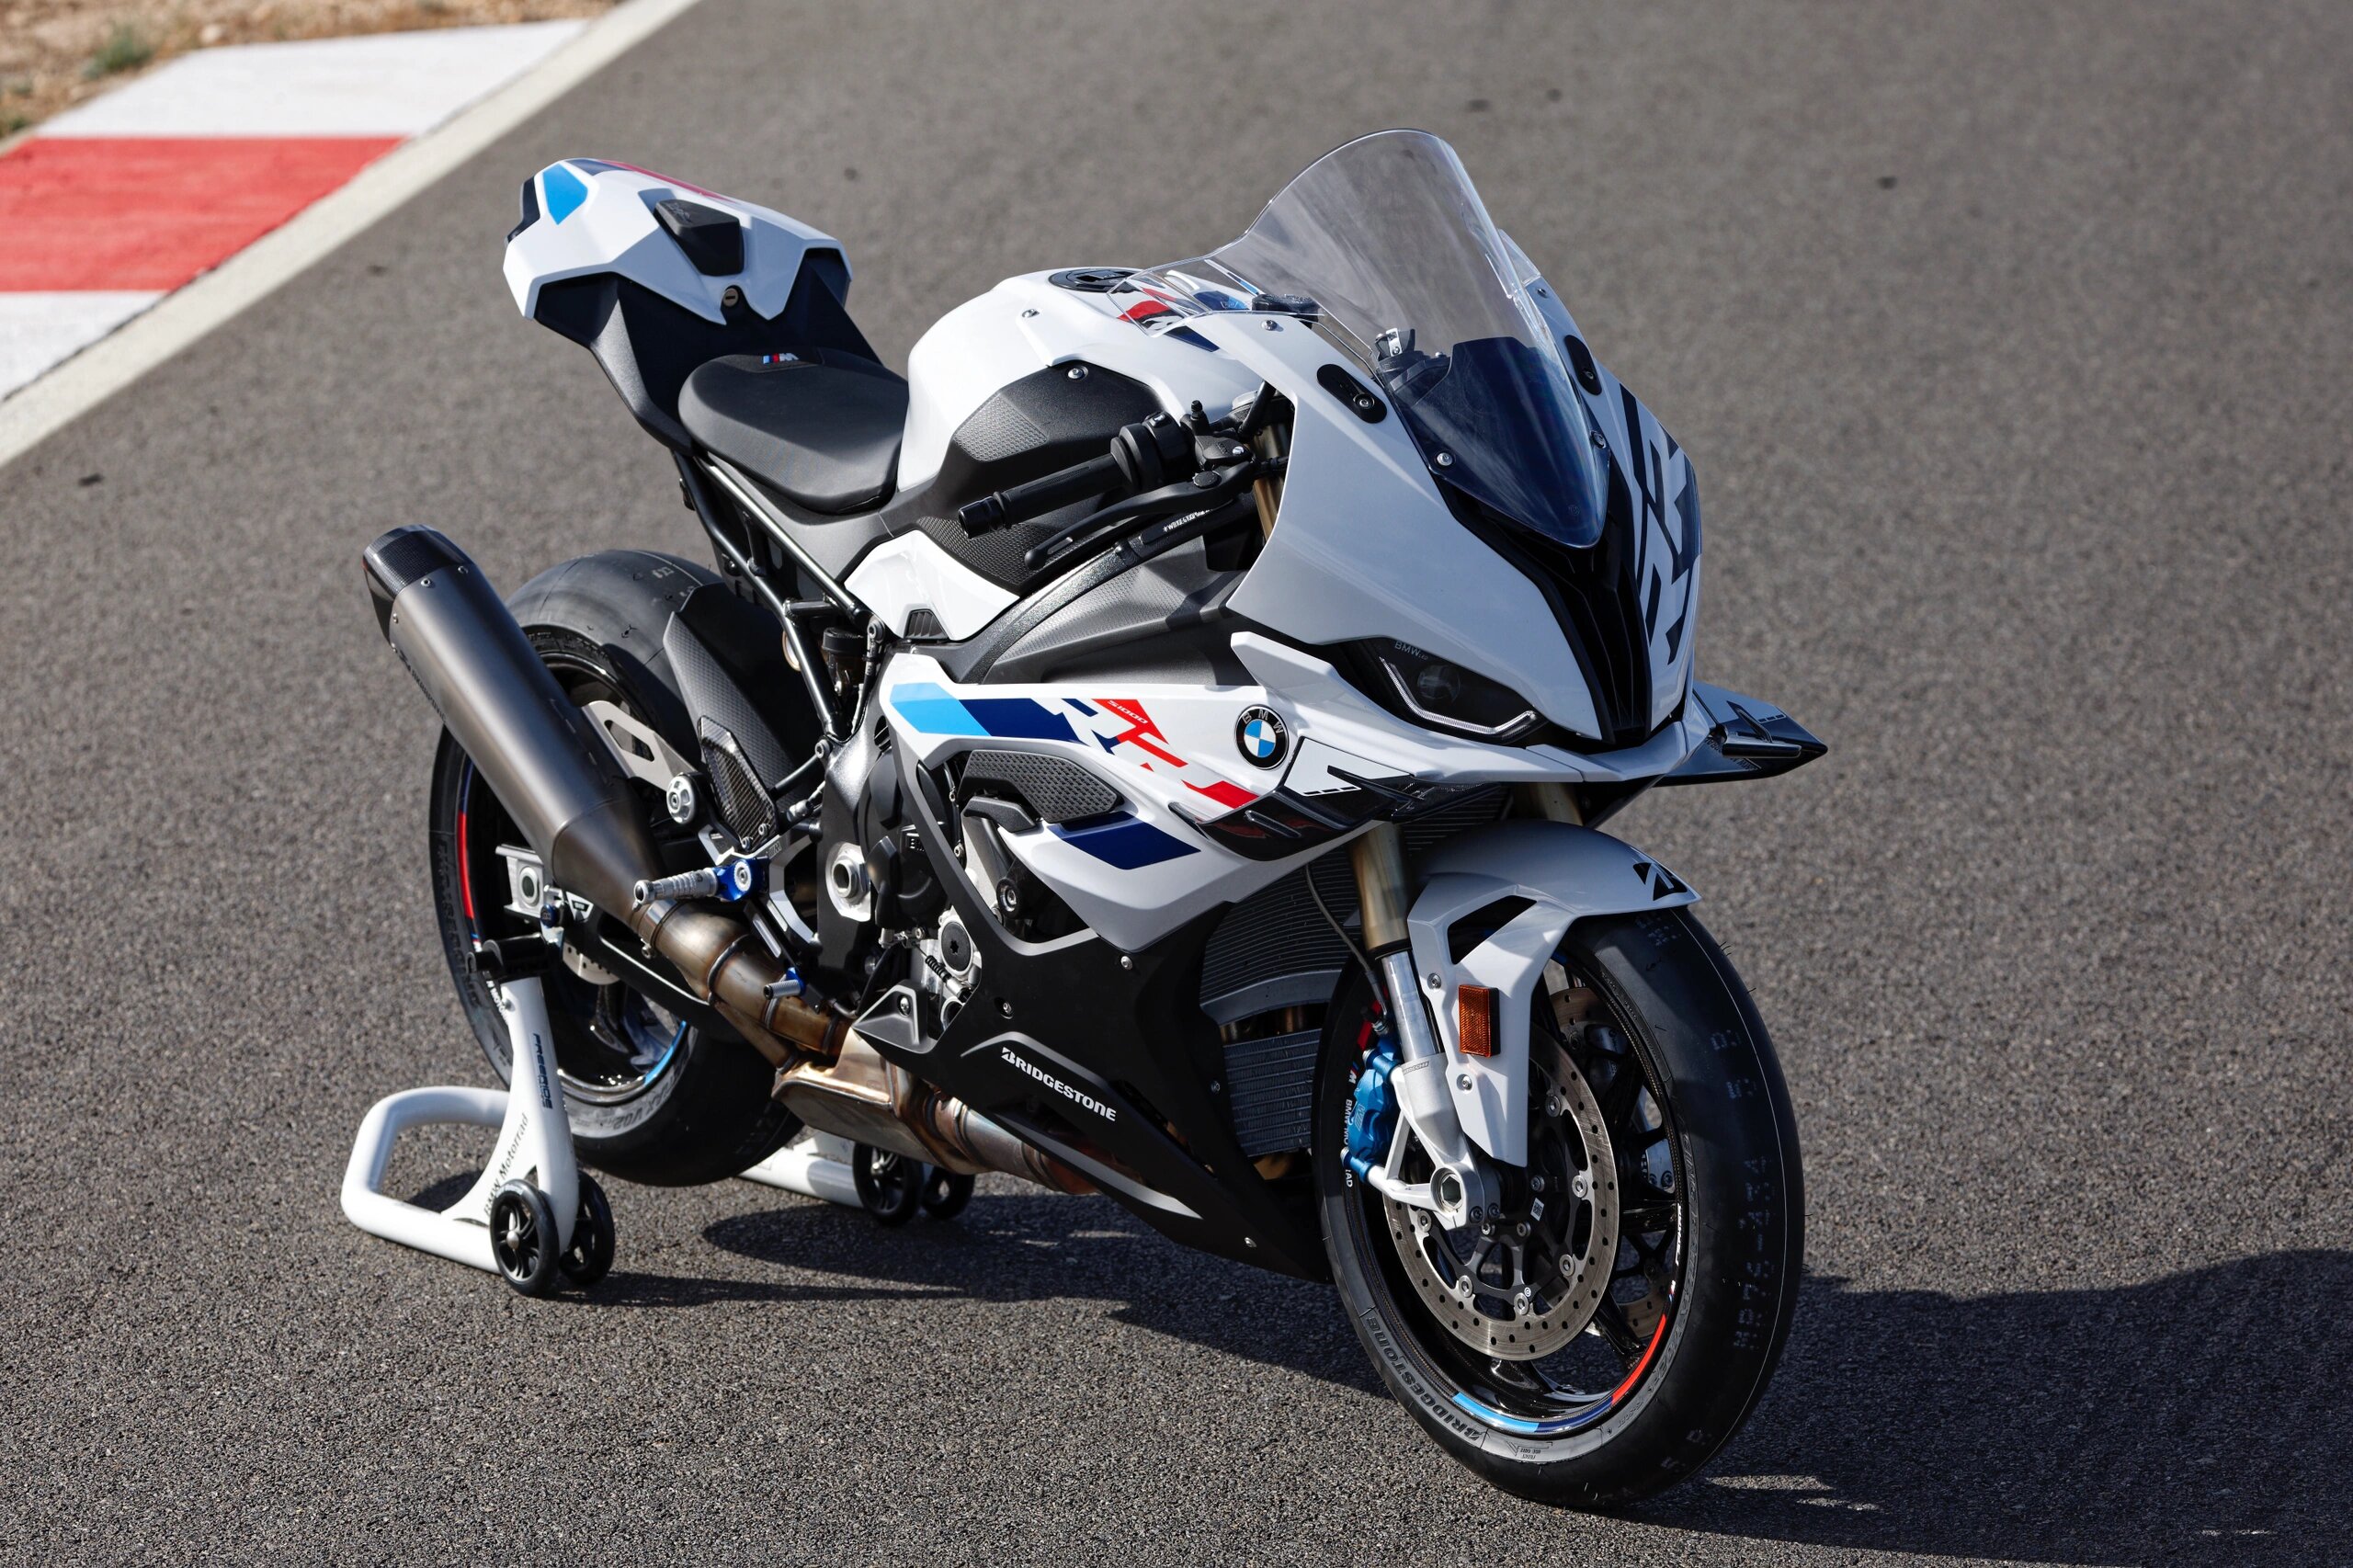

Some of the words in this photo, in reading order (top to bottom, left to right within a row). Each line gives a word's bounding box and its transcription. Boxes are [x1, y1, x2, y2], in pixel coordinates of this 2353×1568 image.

[1394, 641, 1421, 656] BMW
[1108, 699, 1149, 724] S1000
[1241, 709, 1284, 734] BMW
[1001, 1046, 1117, 1122] BRIDGESTONE
[498, 1111, 529, 1181] Motorrad
[1367, 1316, 1481, 1441] BRIDGESTONE
